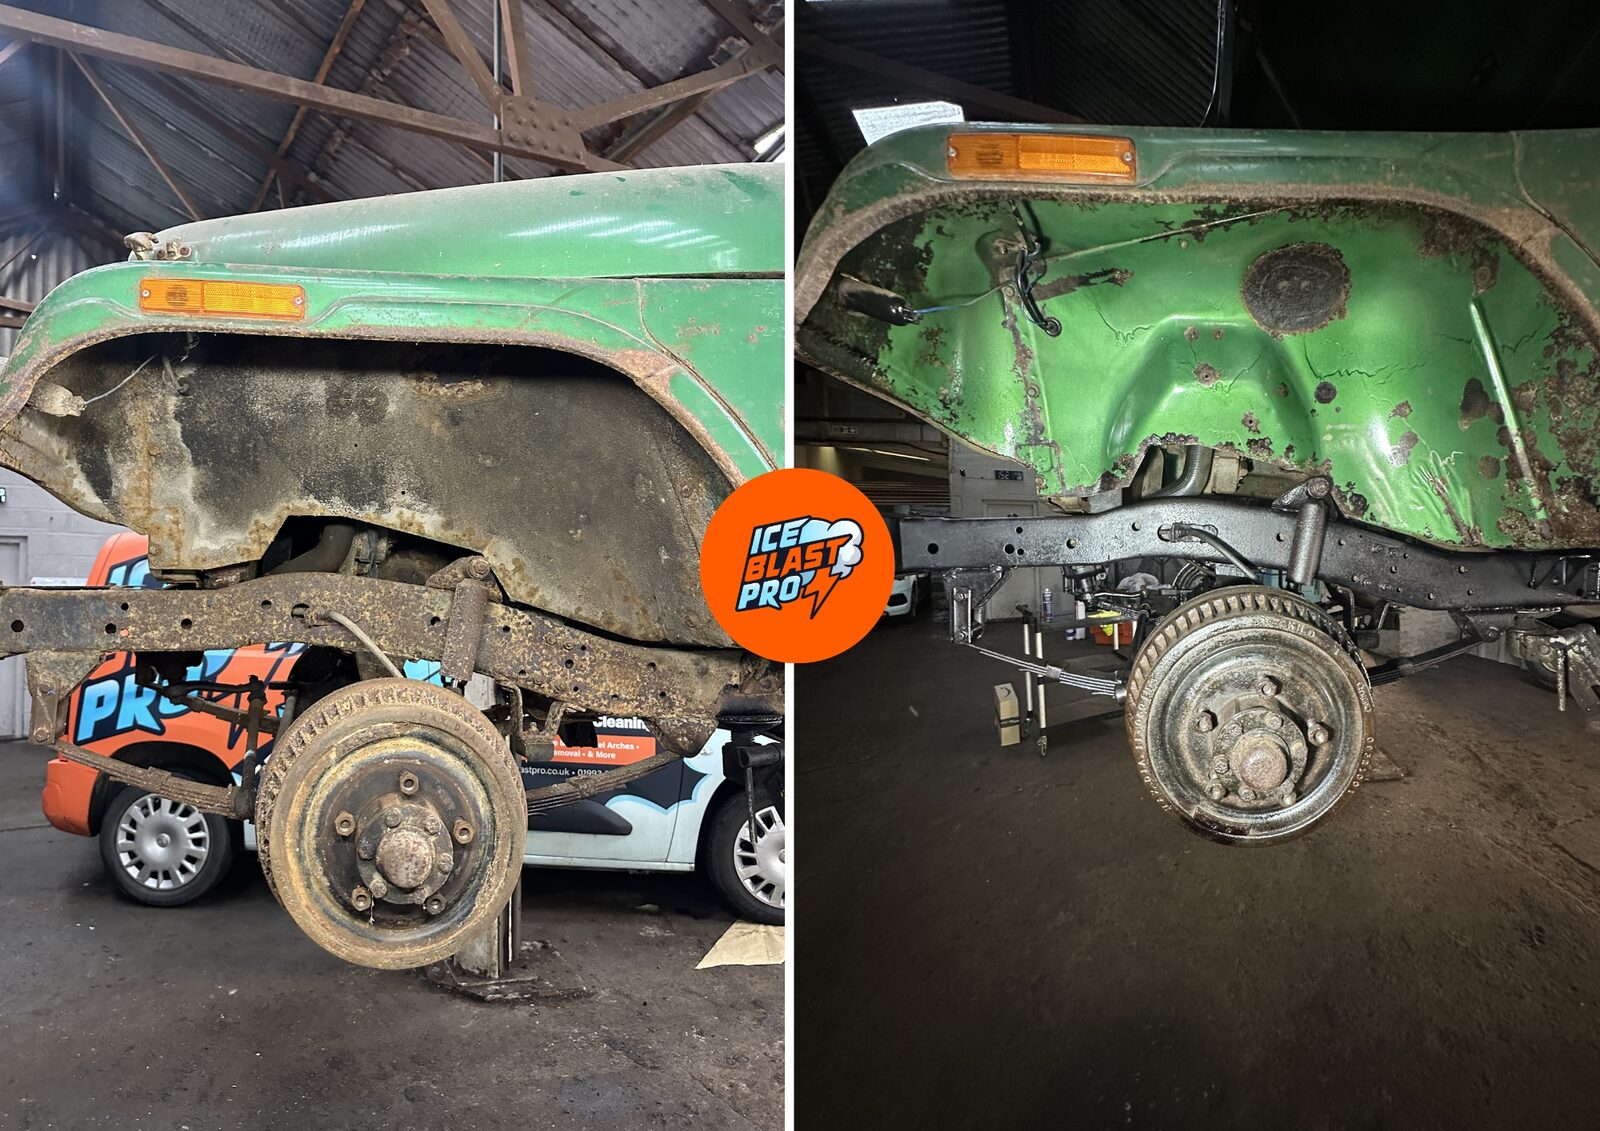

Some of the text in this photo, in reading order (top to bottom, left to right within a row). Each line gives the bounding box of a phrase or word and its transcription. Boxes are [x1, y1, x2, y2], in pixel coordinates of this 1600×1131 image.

[592, 715, 650, 732] Cleanin
[607, 742, 635, 750] Arches
[596, 751, 616, 759] More
[520, 766, 570, 776] astpro.co.uk
